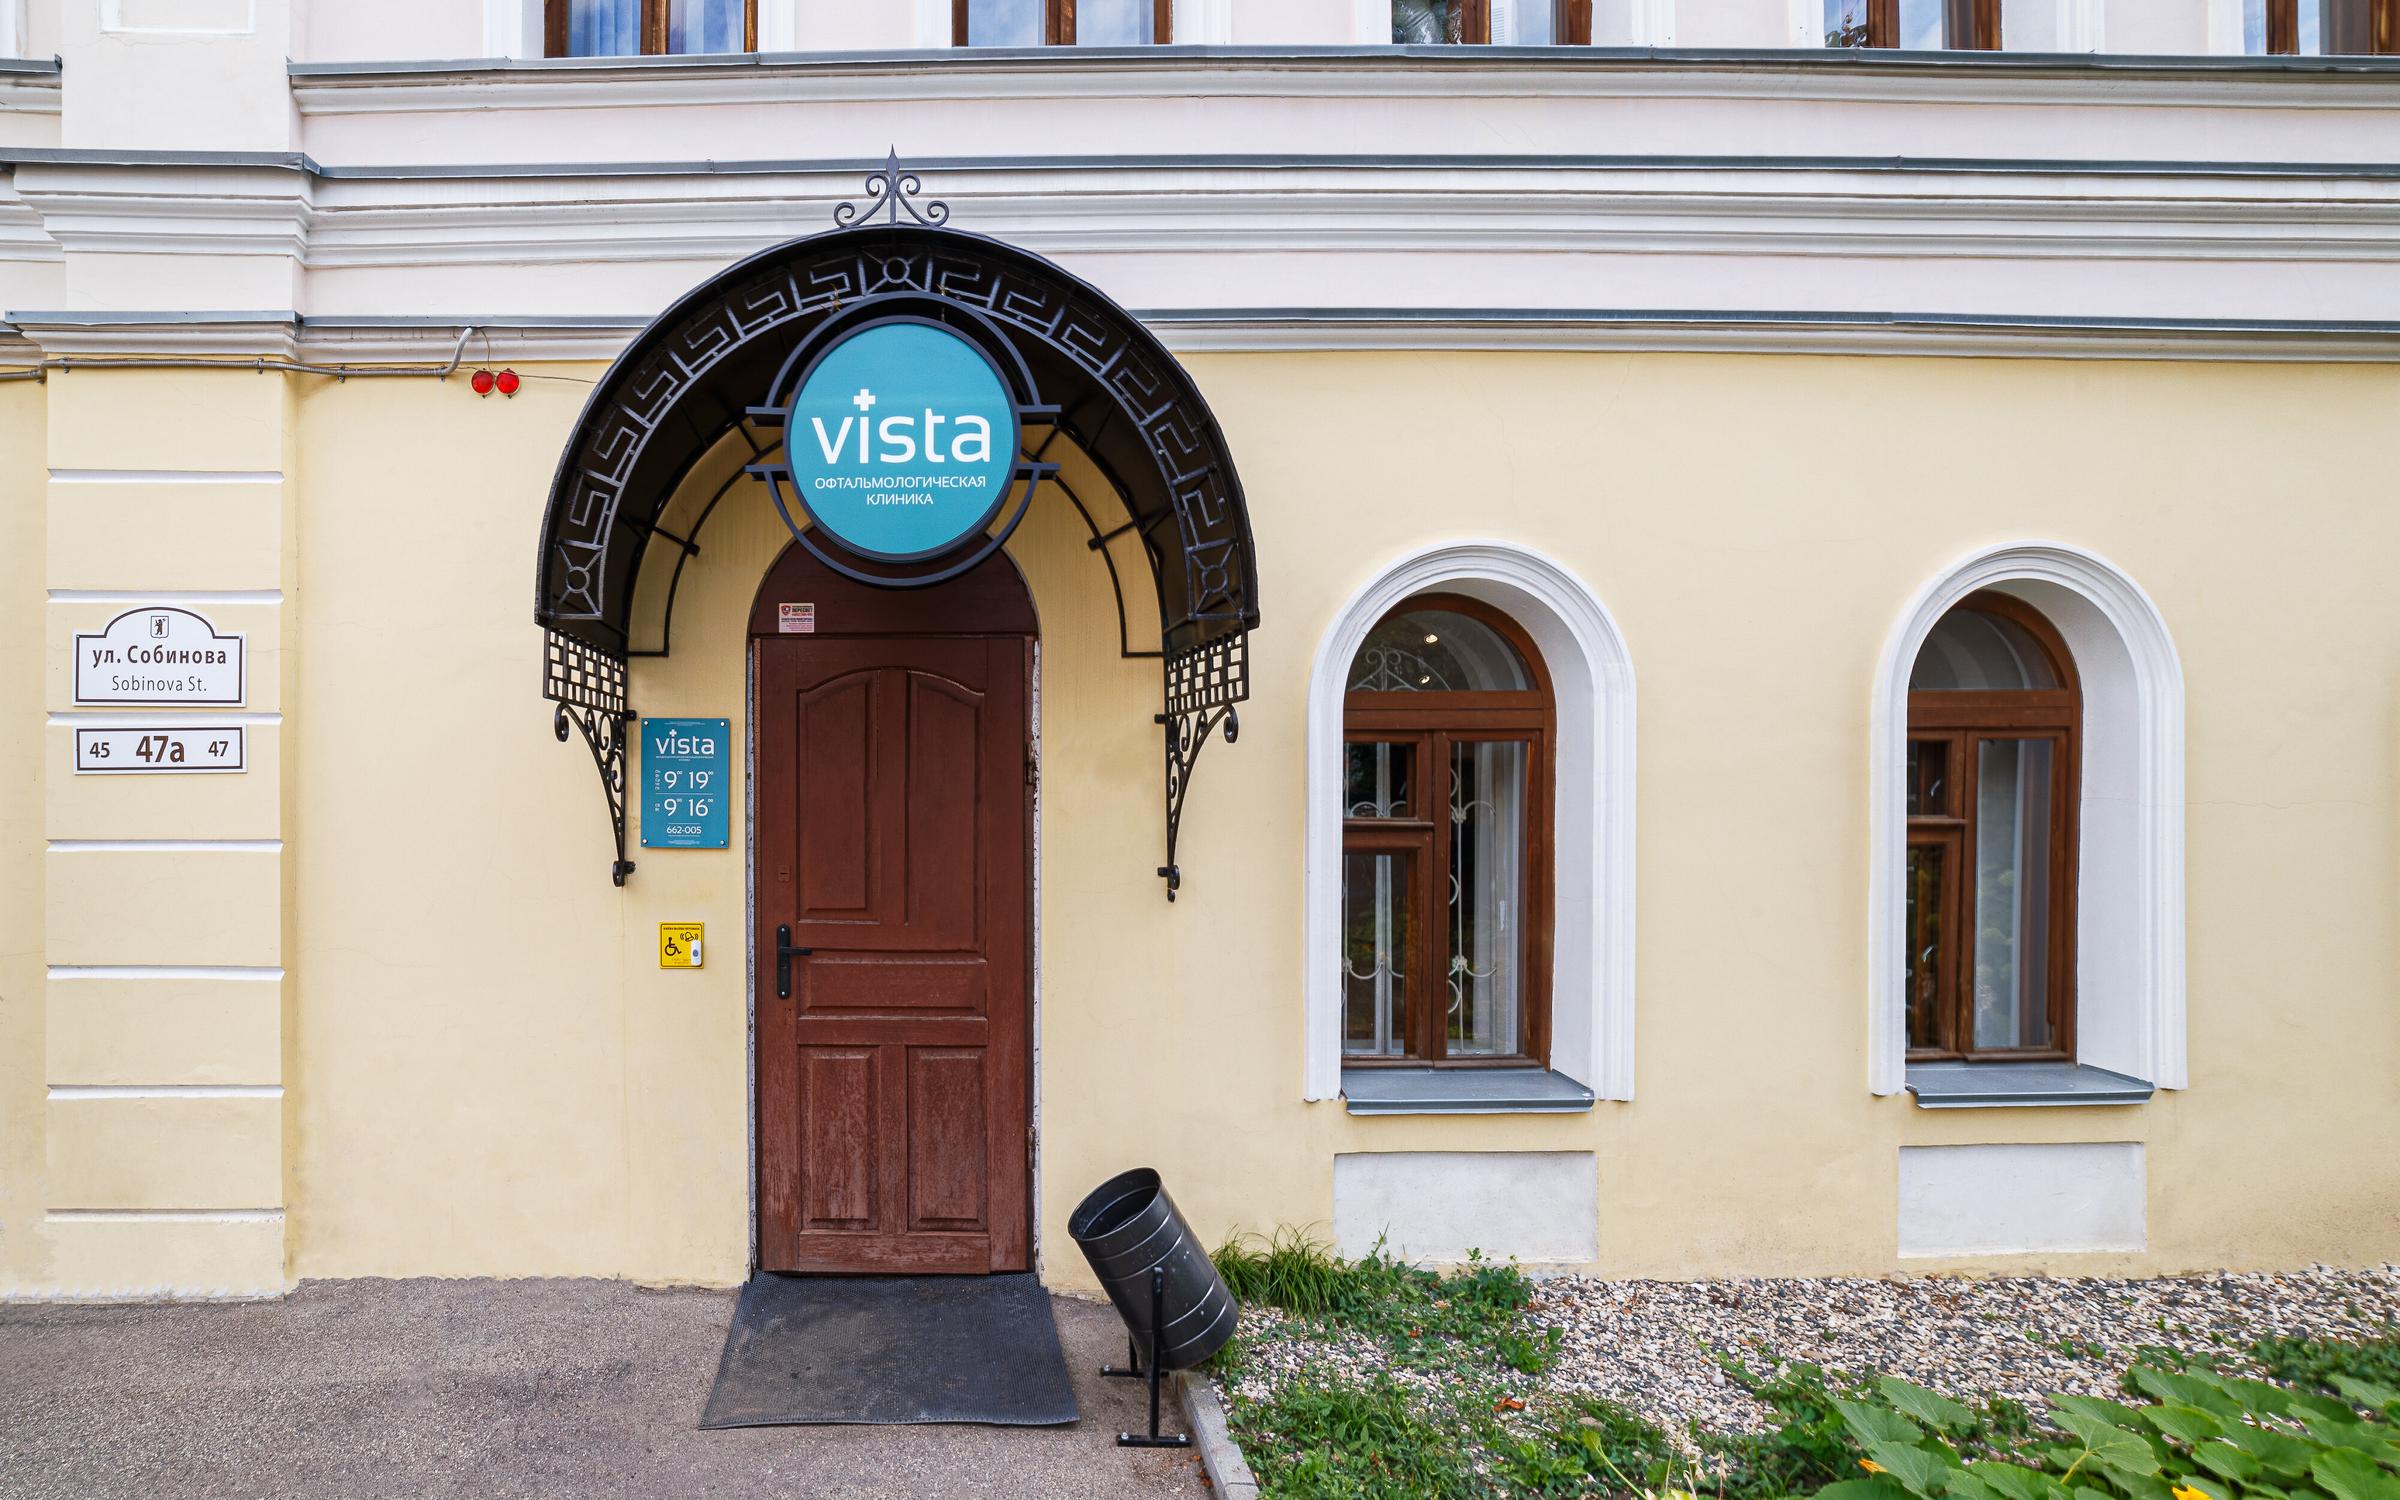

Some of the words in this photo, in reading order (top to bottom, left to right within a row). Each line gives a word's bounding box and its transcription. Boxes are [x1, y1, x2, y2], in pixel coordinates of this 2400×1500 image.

[811, 389, 991, 465] vista
[814, 475, 987, 490] ОФТАЛЬМОЛОГИЧЕСКАЯ
[866, 493, 934, 506] КЛИНИКА
[92, 649, 121, 669] ул.
[127, 645, 227, 665] Собинова
[111, 675, 183, 692] Sobinova
[187, 675, 208, 692] St.
[89, 742, 111, 758] 45
[135, 735, 185, 763] 47а
[208, 741, 229, 757] 47
[655, 729, 715, 755] vista
[666, 825, 702, 835] 662-005
